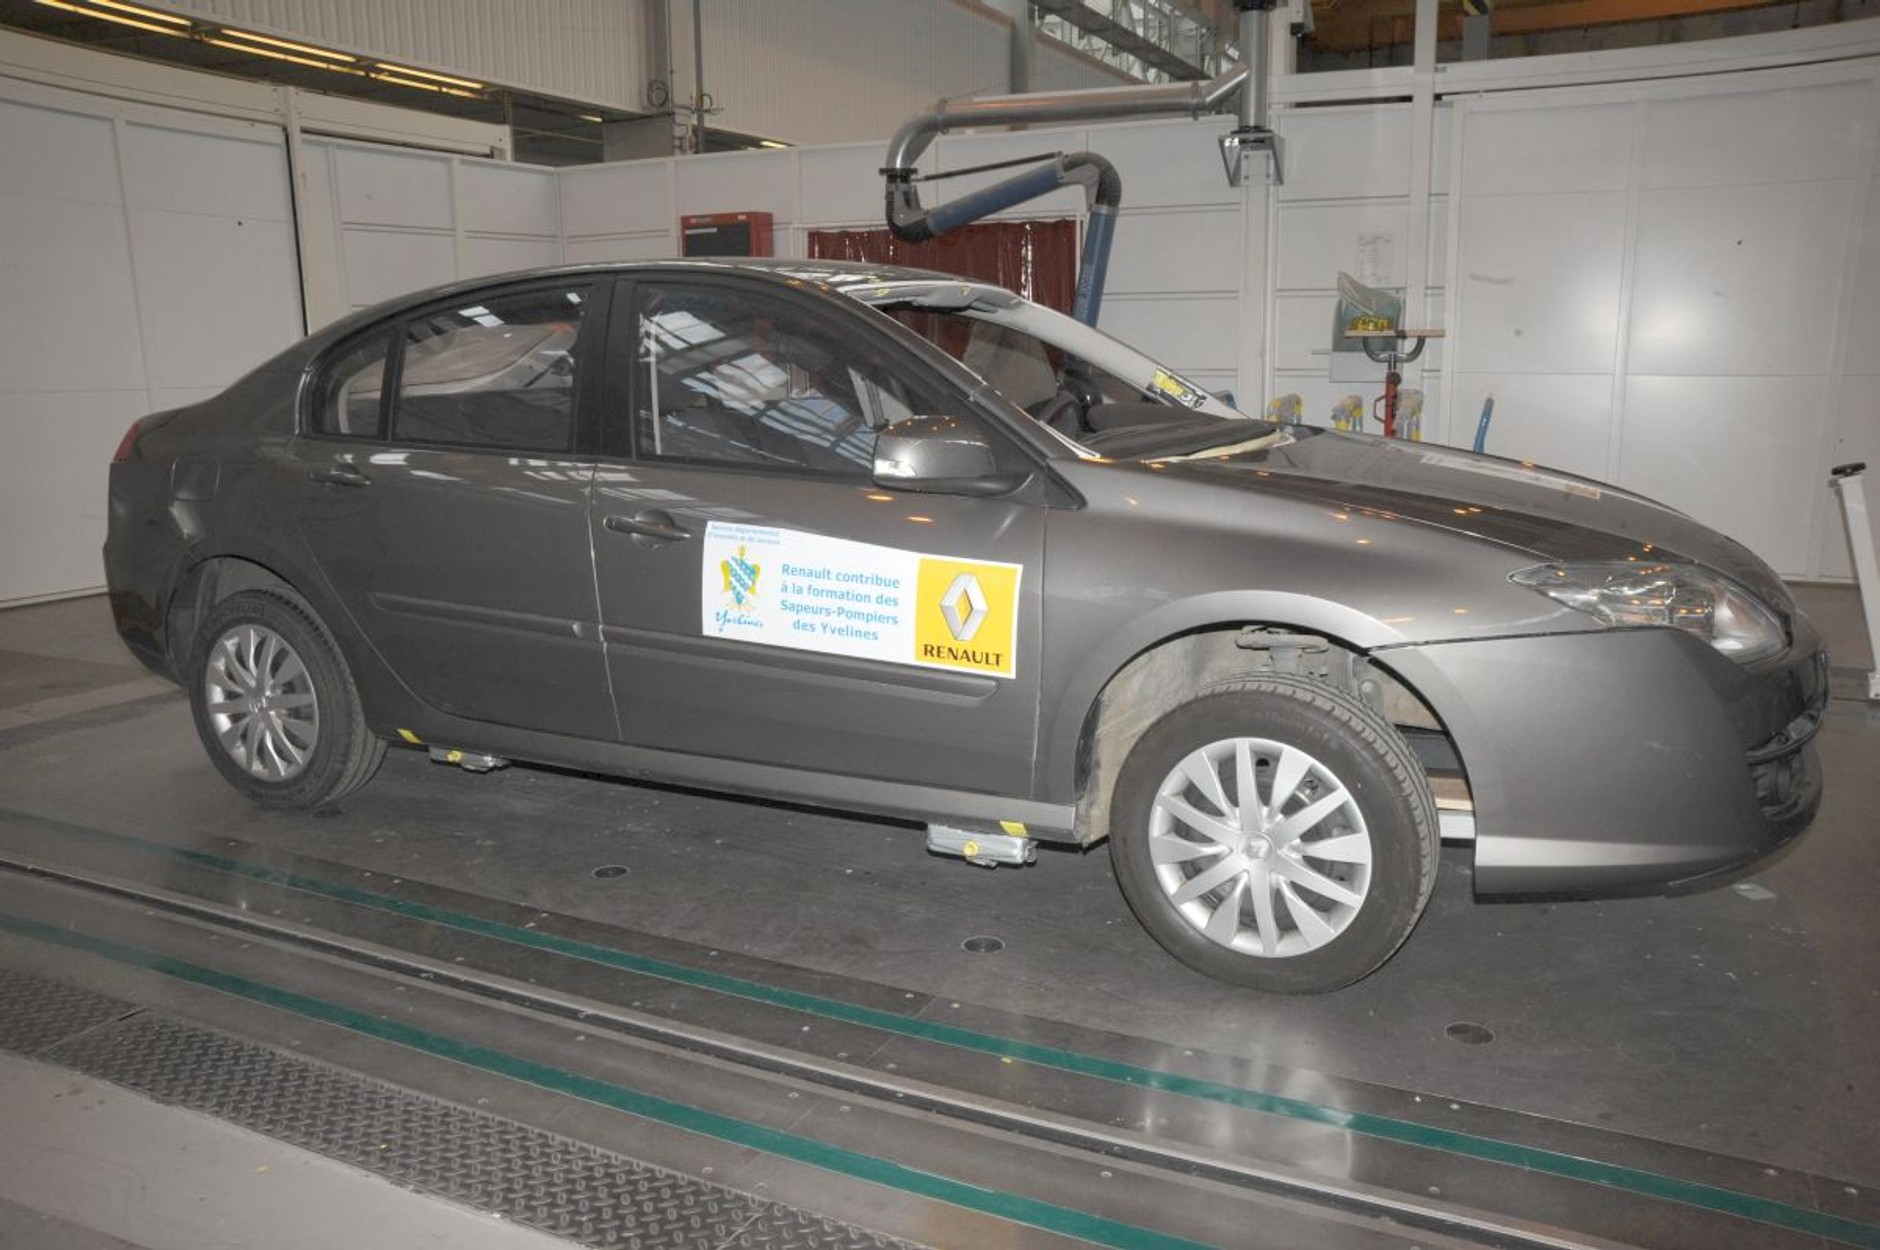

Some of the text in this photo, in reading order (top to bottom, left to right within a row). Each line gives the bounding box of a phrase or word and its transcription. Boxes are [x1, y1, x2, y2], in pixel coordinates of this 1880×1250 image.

[781, 563, 900, 589] Renault contribue
[780, 580, 899, 607] à la formation des
[780, 599, 899, 625] Sapeurs-Pompiers
[792, 619, 879, 640] des Yvelines
[923, 643, 1004, 666] RENAULT
